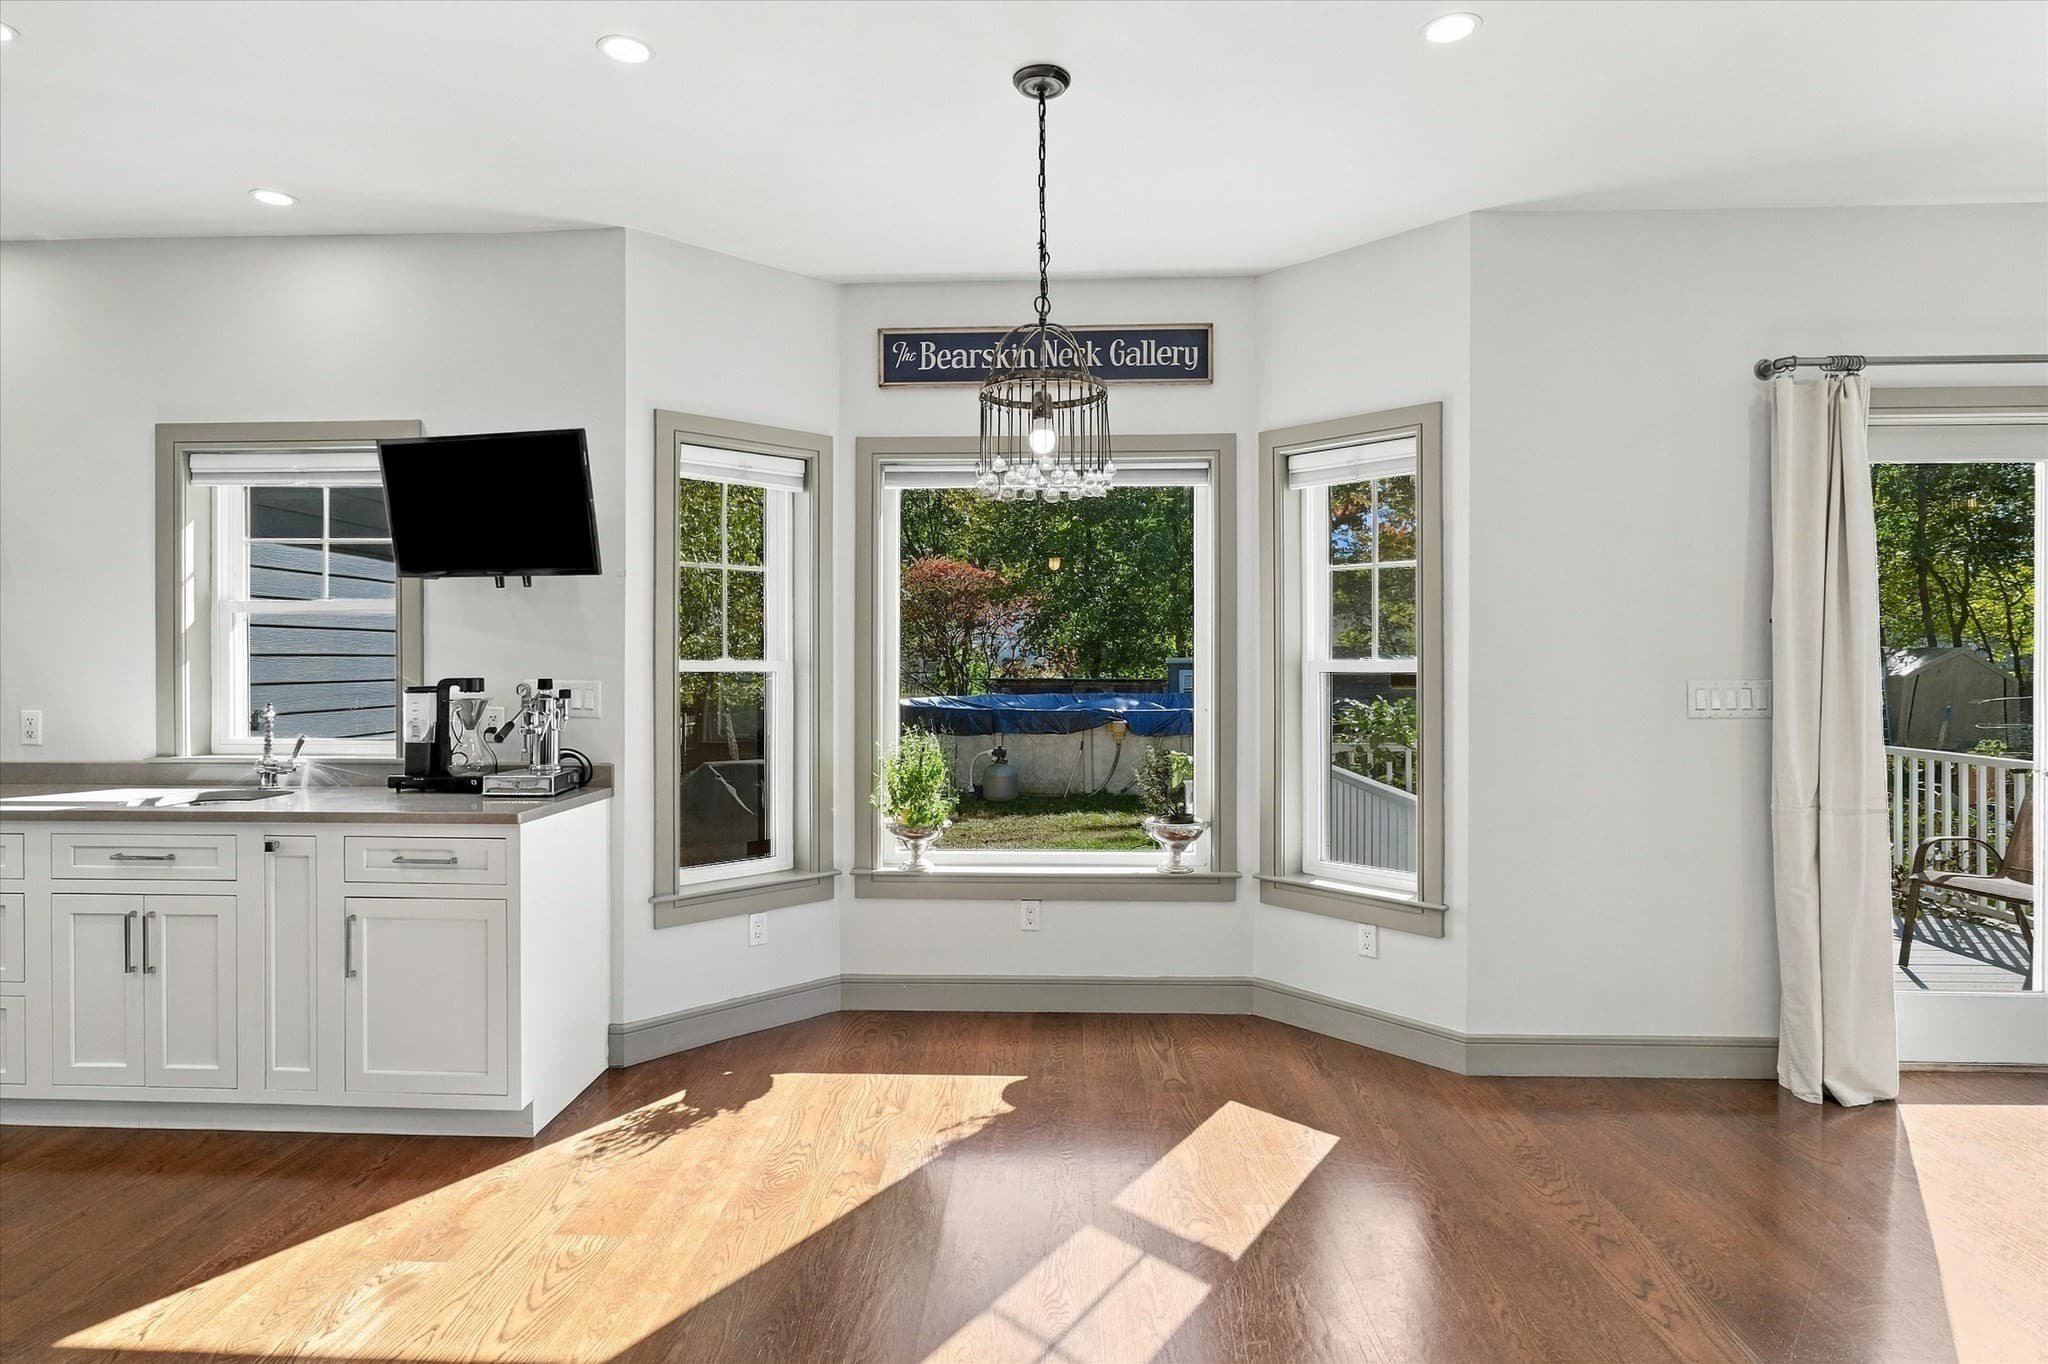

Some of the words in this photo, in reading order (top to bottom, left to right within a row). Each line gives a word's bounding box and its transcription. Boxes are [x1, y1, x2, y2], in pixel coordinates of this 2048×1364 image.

[892, 341, 917, 368] The
[918, 341, 1037, 370] Bearskin
[1044, 339, 1103, 368] Neck
[1109, 338, 1198, 371] Gallery
